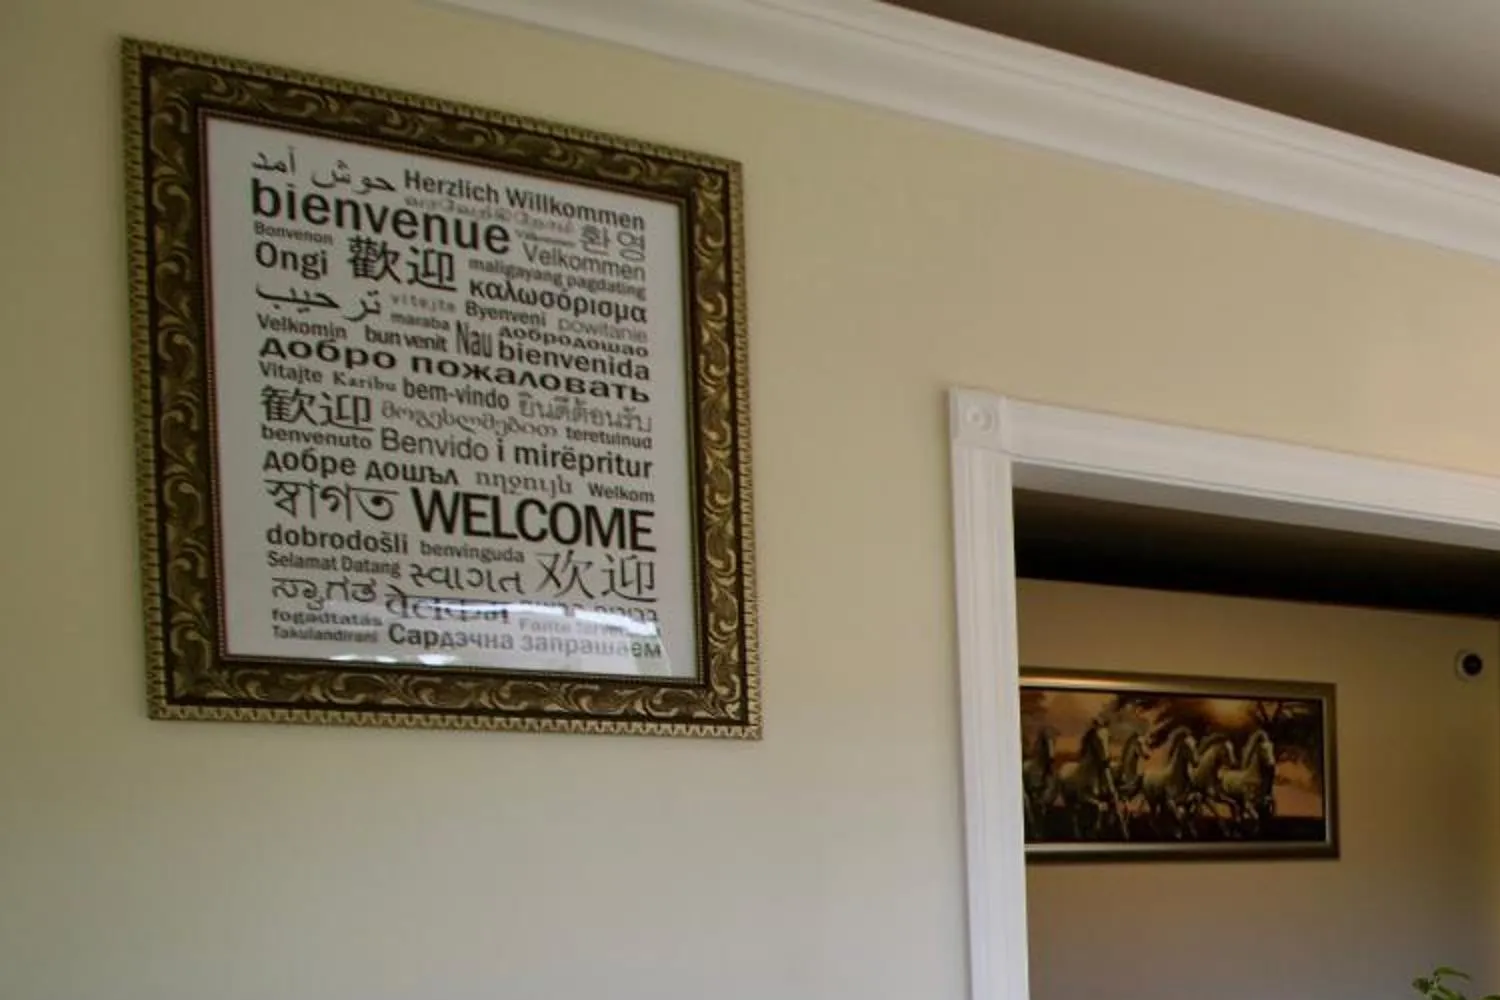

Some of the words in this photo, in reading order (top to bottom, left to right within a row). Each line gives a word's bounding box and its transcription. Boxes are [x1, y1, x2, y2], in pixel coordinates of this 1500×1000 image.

[252, 177, 511, 254] bienvenue
[404, 168, 500, 203] Herzlich
[505, 185, 645, 231] Willkommen
[254, 220, 333, 246] Bonvenon
[255, 240, 329, 280] Ongi
[523, 240, 646, 281] Velkommen
[256, 312, 348, 339] Velkomin
[465, 300, 547, 327] Byenveni
[456, 319, 493, 359] Nau
[257, 360, 323, 384] Vitajte
[498, 339, 651, 381] bienvenida
[333, 370, 397, 391] Karibu
[402, 376, 510, 411] bem-vindo
[261, 422, 373, 450] benvenuto
[381, 426, 489, 462] Benvido
[497, 438, 505, 462] i
[513, 443, 654, 479] mirëpritur
[587, 480, 655, 503] Welkom
[410, 487, 658, 553] WELCOME
[266, 522, 409, 556] dobrodošli
[267, 549, 337, 571] Selamat
[340, 555, 402, 579] Datang
[535, 550, 659, 603] 欢迎
